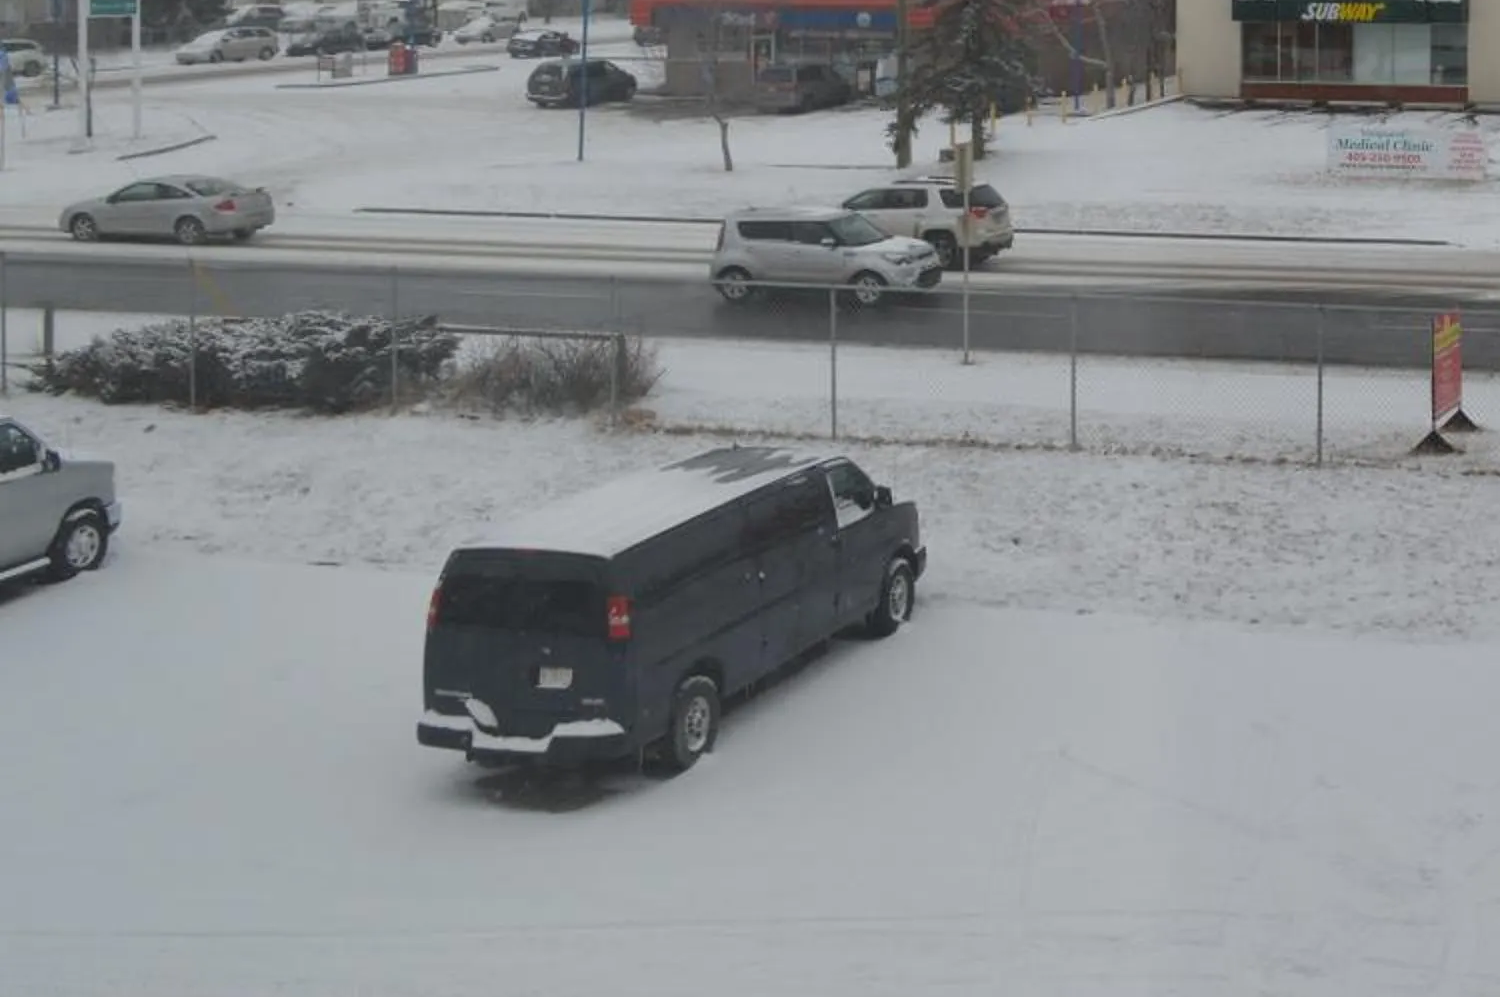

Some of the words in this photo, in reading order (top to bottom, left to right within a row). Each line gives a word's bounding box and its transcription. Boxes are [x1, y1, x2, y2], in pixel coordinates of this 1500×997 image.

[1301, 1, 1386, 22] SUBWAY
[1336, 138, 1391, 152] Medical
[1393, 138, 1436, 153] Clinic
